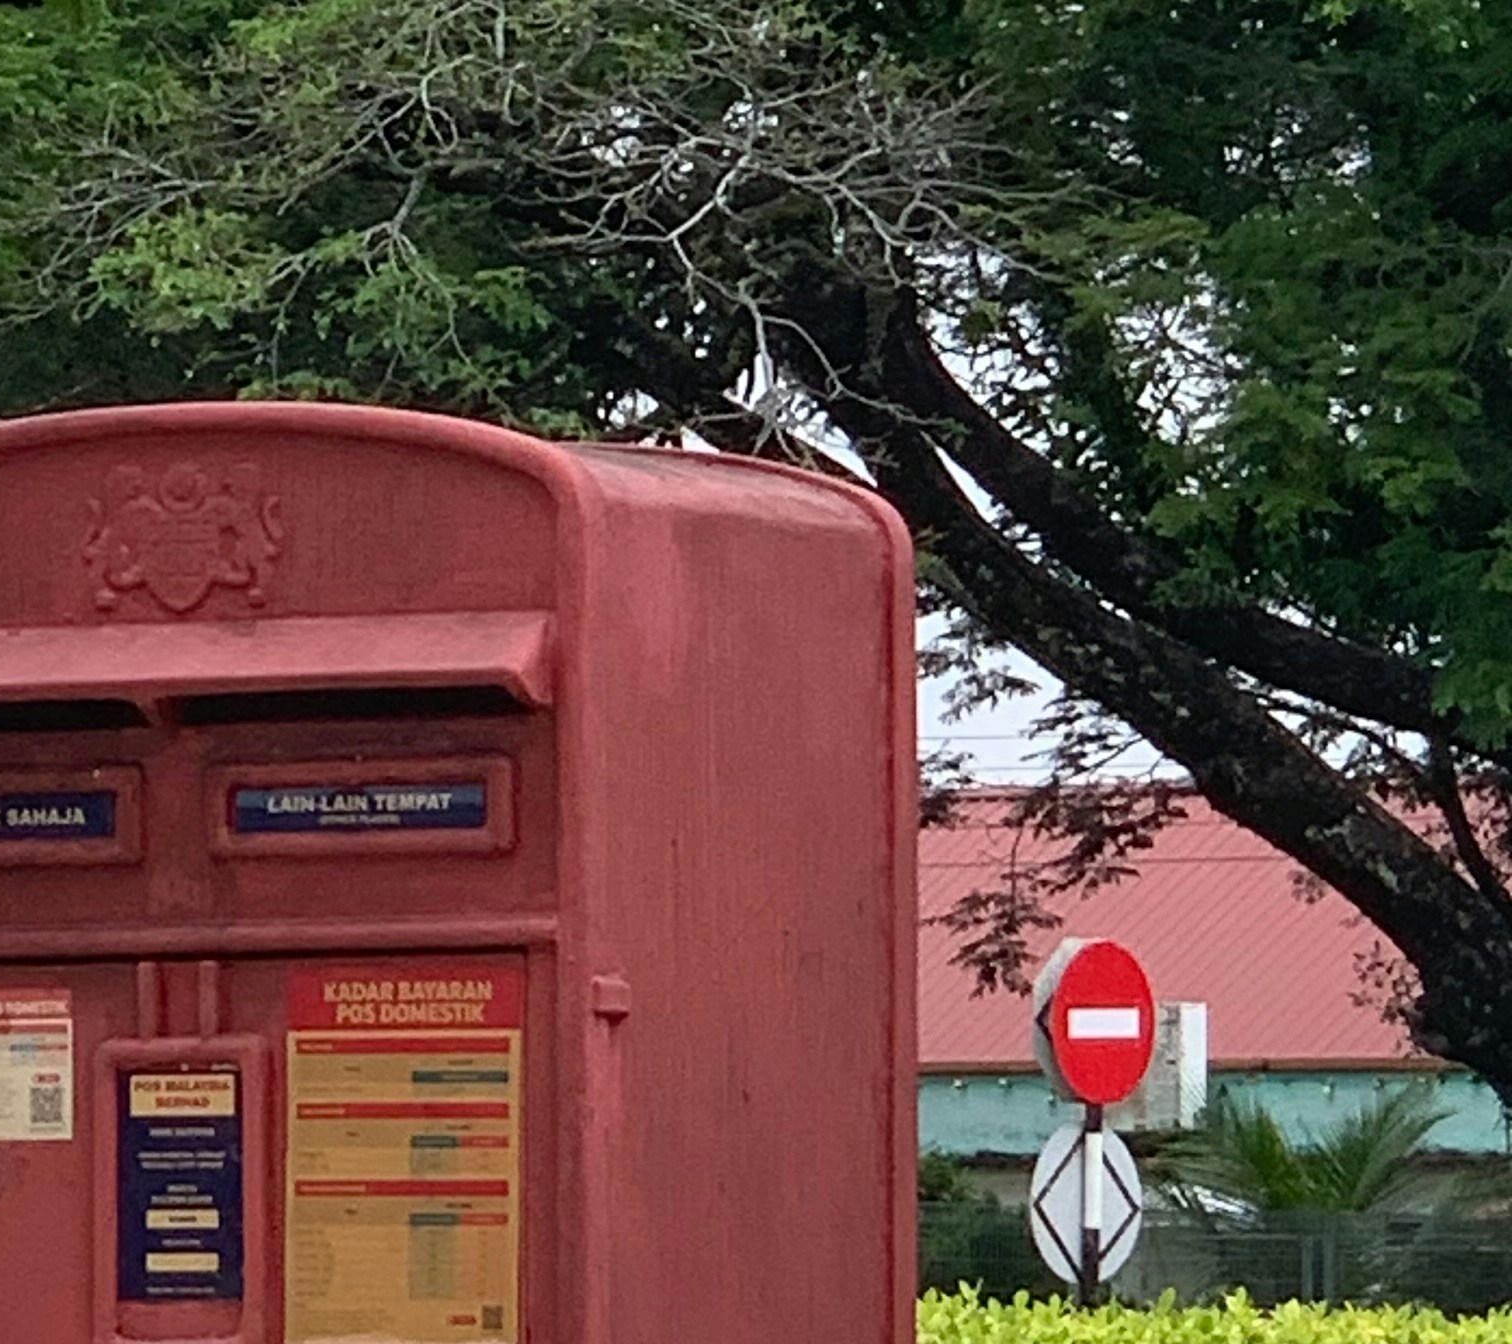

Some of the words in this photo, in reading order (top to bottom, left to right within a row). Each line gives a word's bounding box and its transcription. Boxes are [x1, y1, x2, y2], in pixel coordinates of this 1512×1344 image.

[268, 794, 368, 813] LAIN-LAIN
[374, 792, 452, 811] TEMPAT
[6, 807, 85, 826] SAHAJA
[324, 981, 393, 1002] KADAR
[397, 980, 492, 1000] BAYARAN
[337, 1003, 374, 1024] POS
[379, 1003, 485, 1022] DOMESTIK
